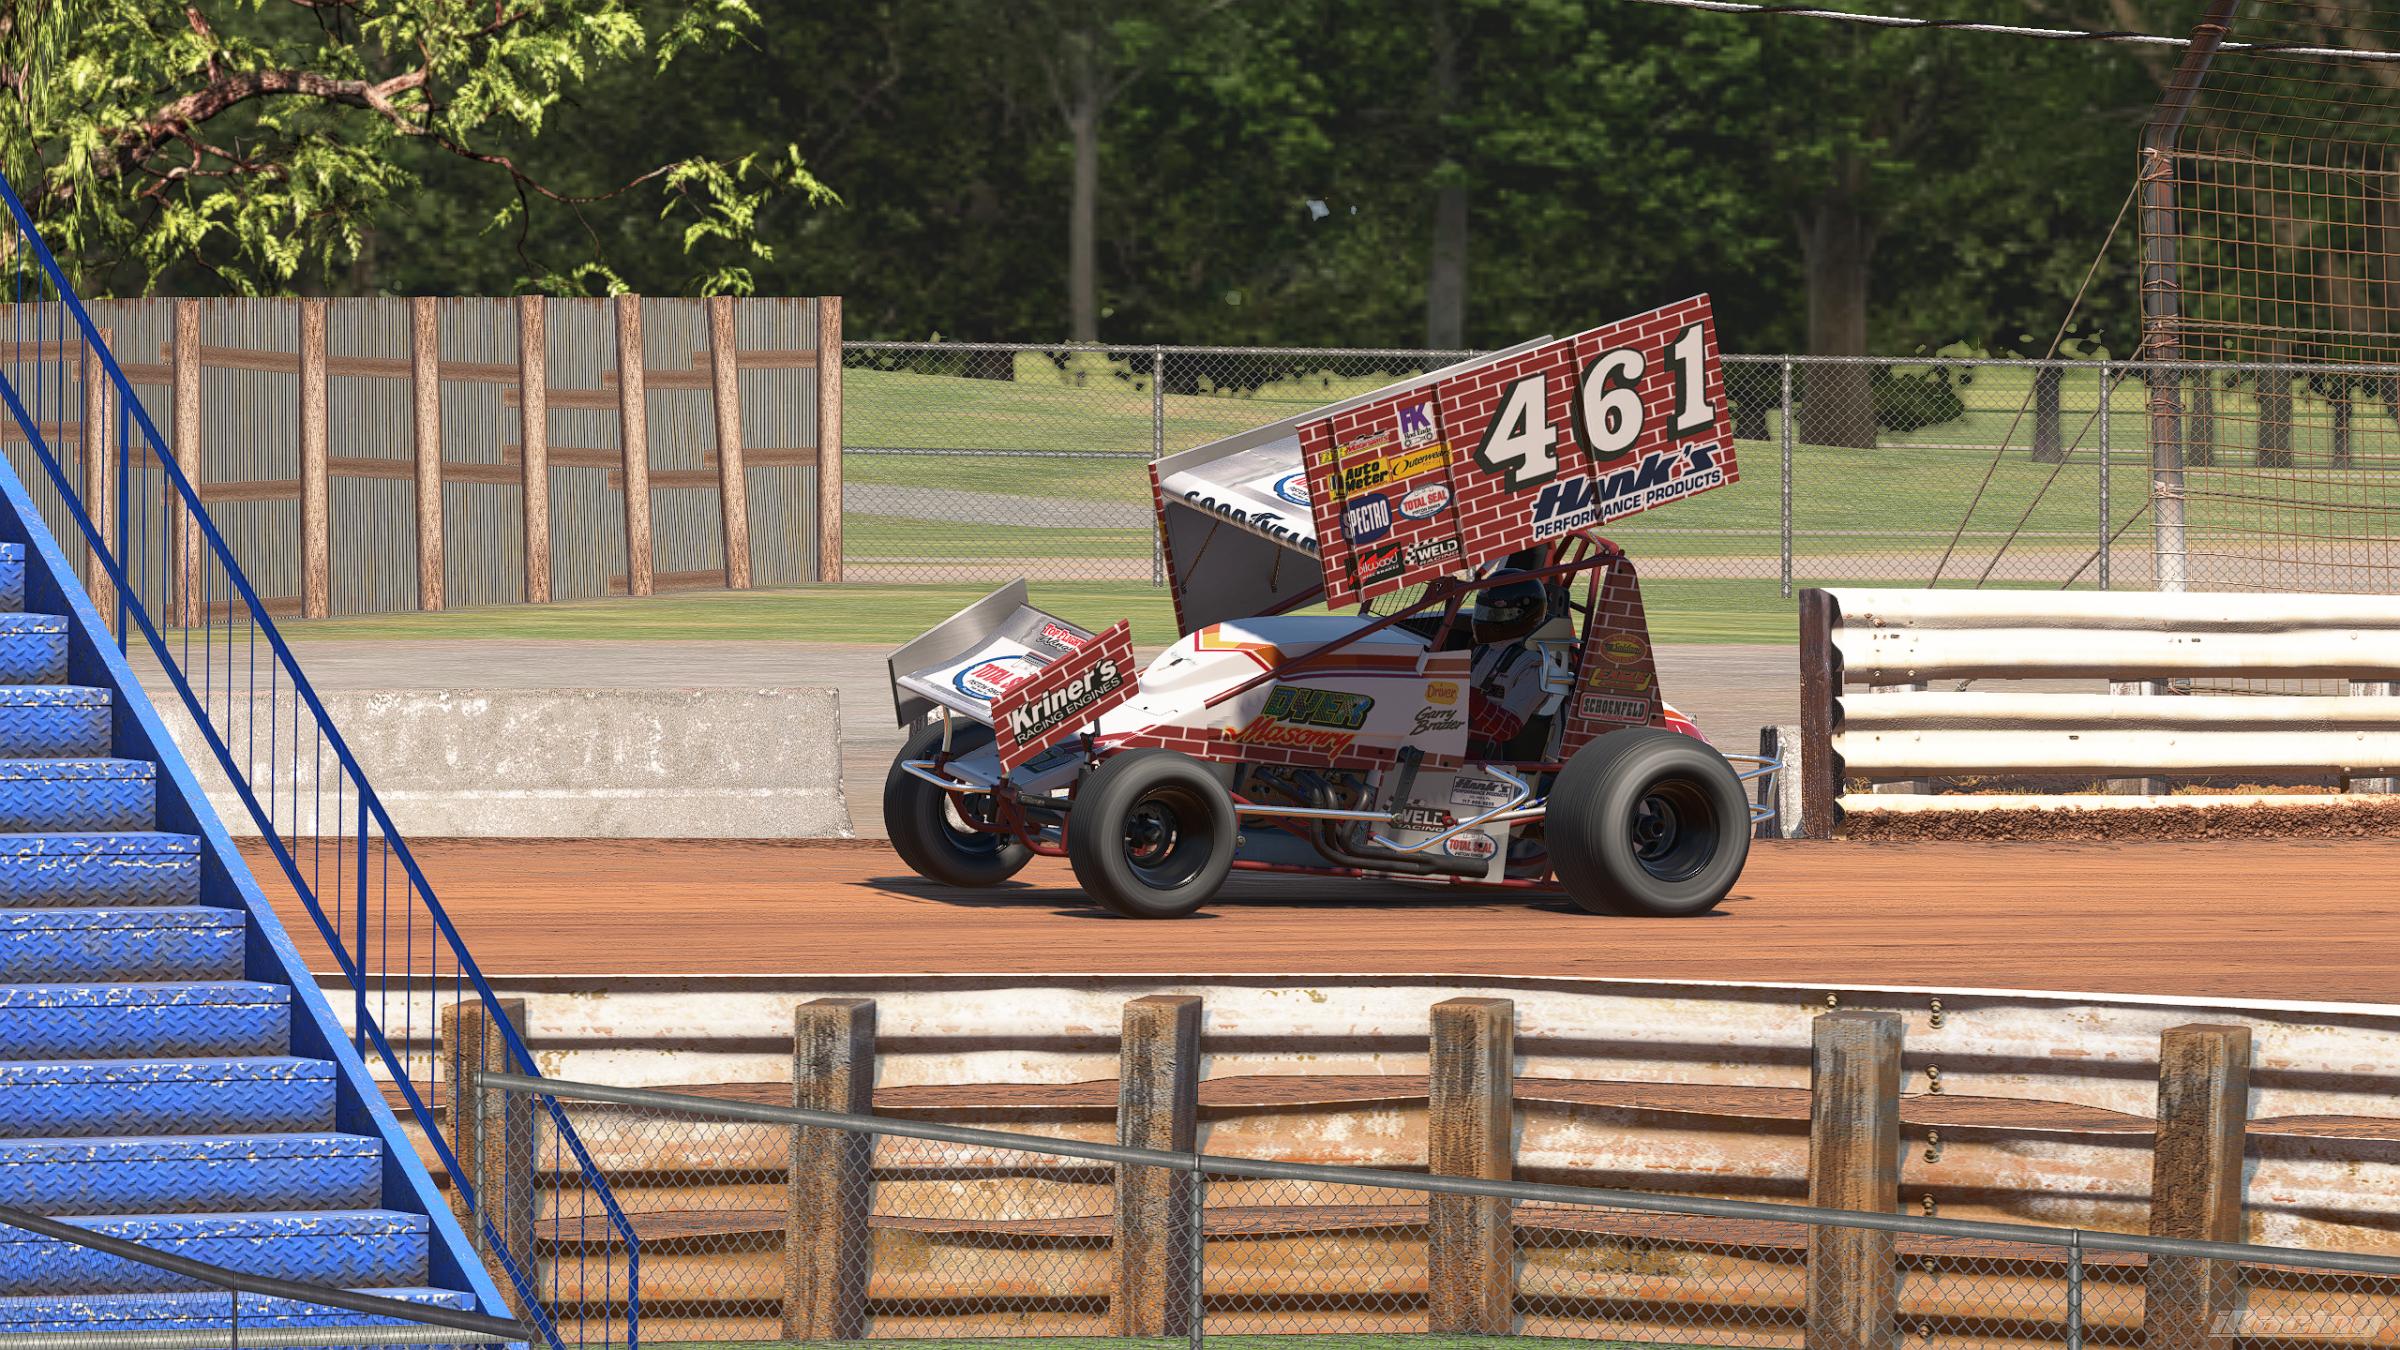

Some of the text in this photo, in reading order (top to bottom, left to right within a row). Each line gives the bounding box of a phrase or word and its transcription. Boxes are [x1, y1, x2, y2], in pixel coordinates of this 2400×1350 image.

[1400, 404, 1430, 433] FK
[1482, 322, 1716, 485] 461
[1346, 461, 1379, 480] Auto
[1346, 470, 1388, 492] Meter
[1534, 442, 1720, 524] Hank's
[1403, 496, 1428, 511] TOTAL
[1428, 490, 1447, 505] SEAL
[1536, 470, 1720, 538] PERFORMANCE PRODUCTS
[1343, 500, 1389, 539] SPECTRO
[1417, 540, 1458, 559] WELD
[971, 664, 1014, 685] TOTAL
[1011, 658, 1117, 736] Kriner's
[1017, 677, 1120, 744] RACING ENGINES
[1263, 686, 1374, 730] DYER
[1584, 698, 1645, 717] SCHOENFELD
[1236, 716, 1354, 759] Masonry
[1450, 839, 1471, 850] TOTAL
